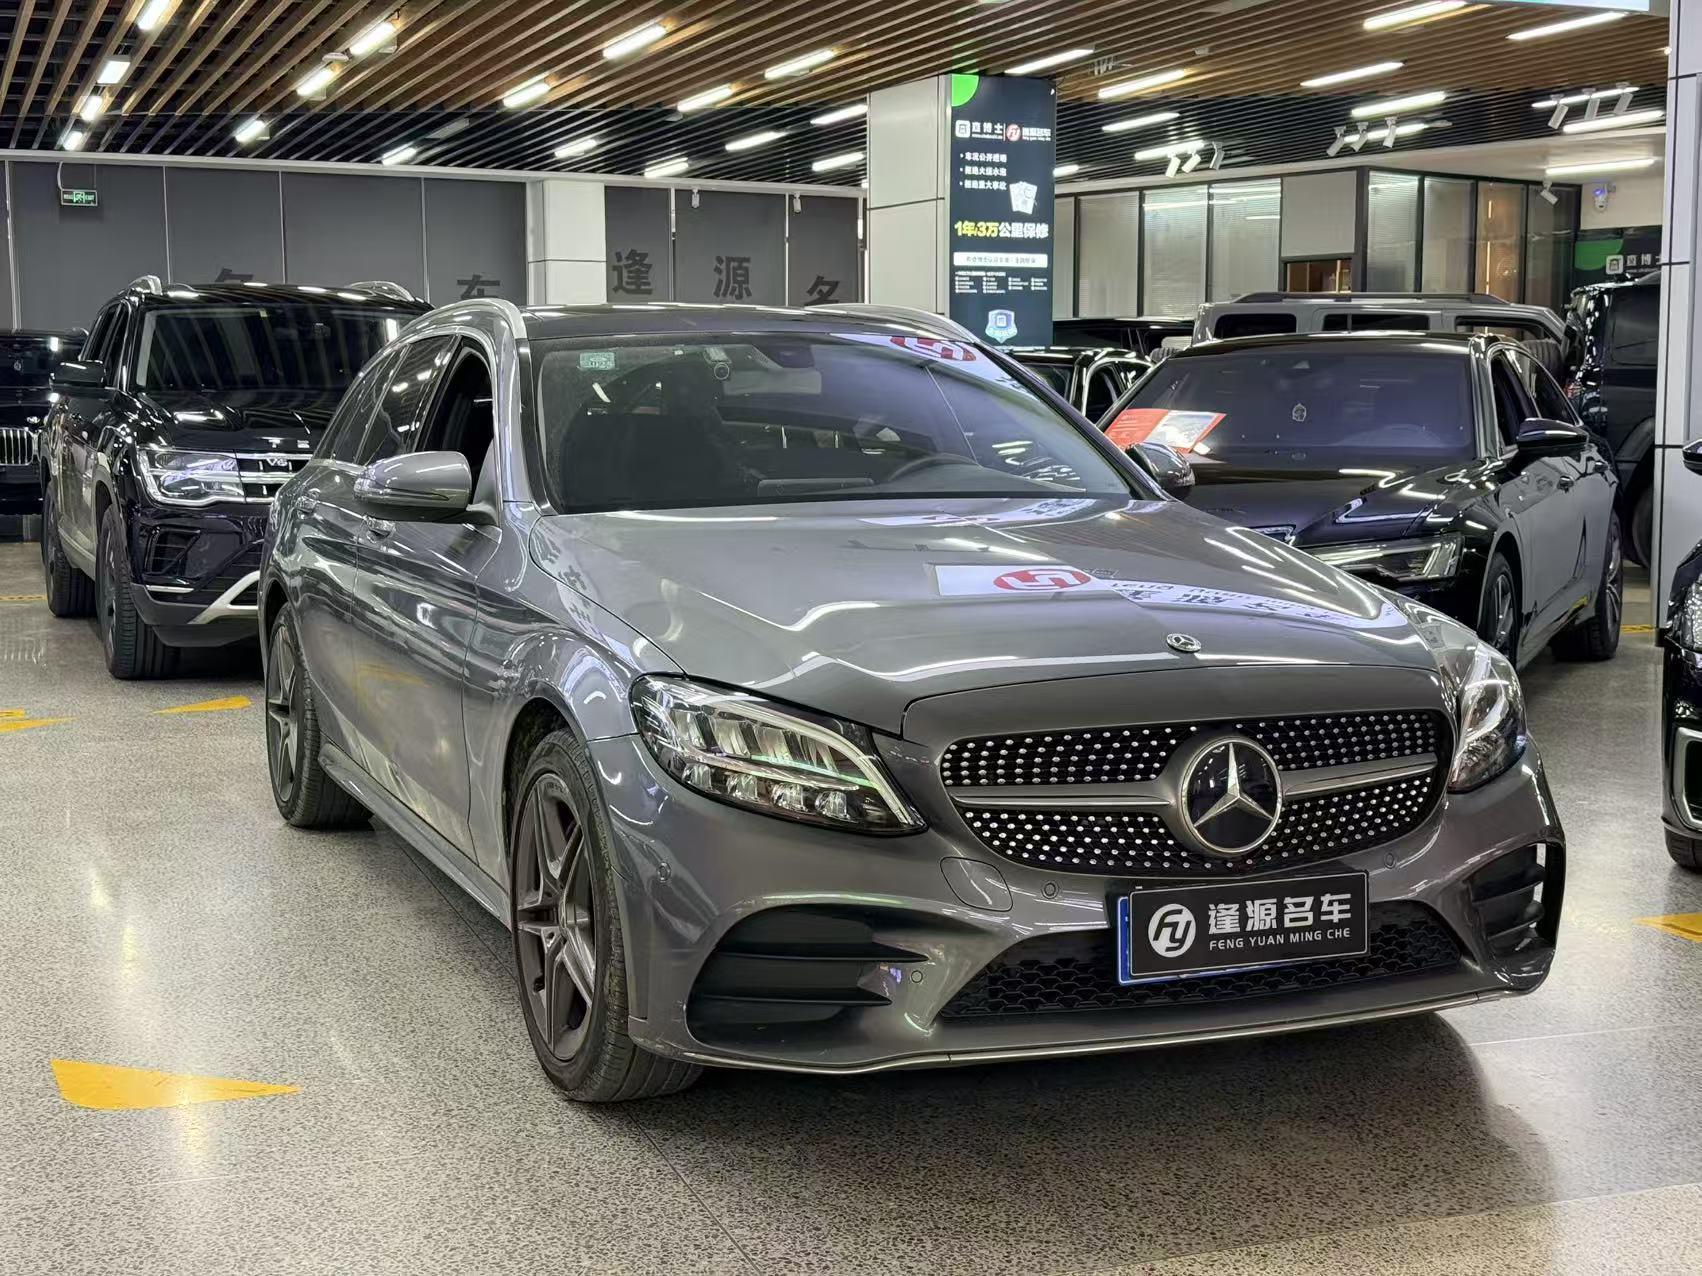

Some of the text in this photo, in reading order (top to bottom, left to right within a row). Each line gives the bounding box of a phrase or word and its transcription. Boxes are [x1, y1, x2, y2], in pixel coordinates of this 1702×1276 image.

[1208, 893, 1351, 935] 逢源名车
[1209, 927, 1351, 951] FENG YUAN MING CHE
